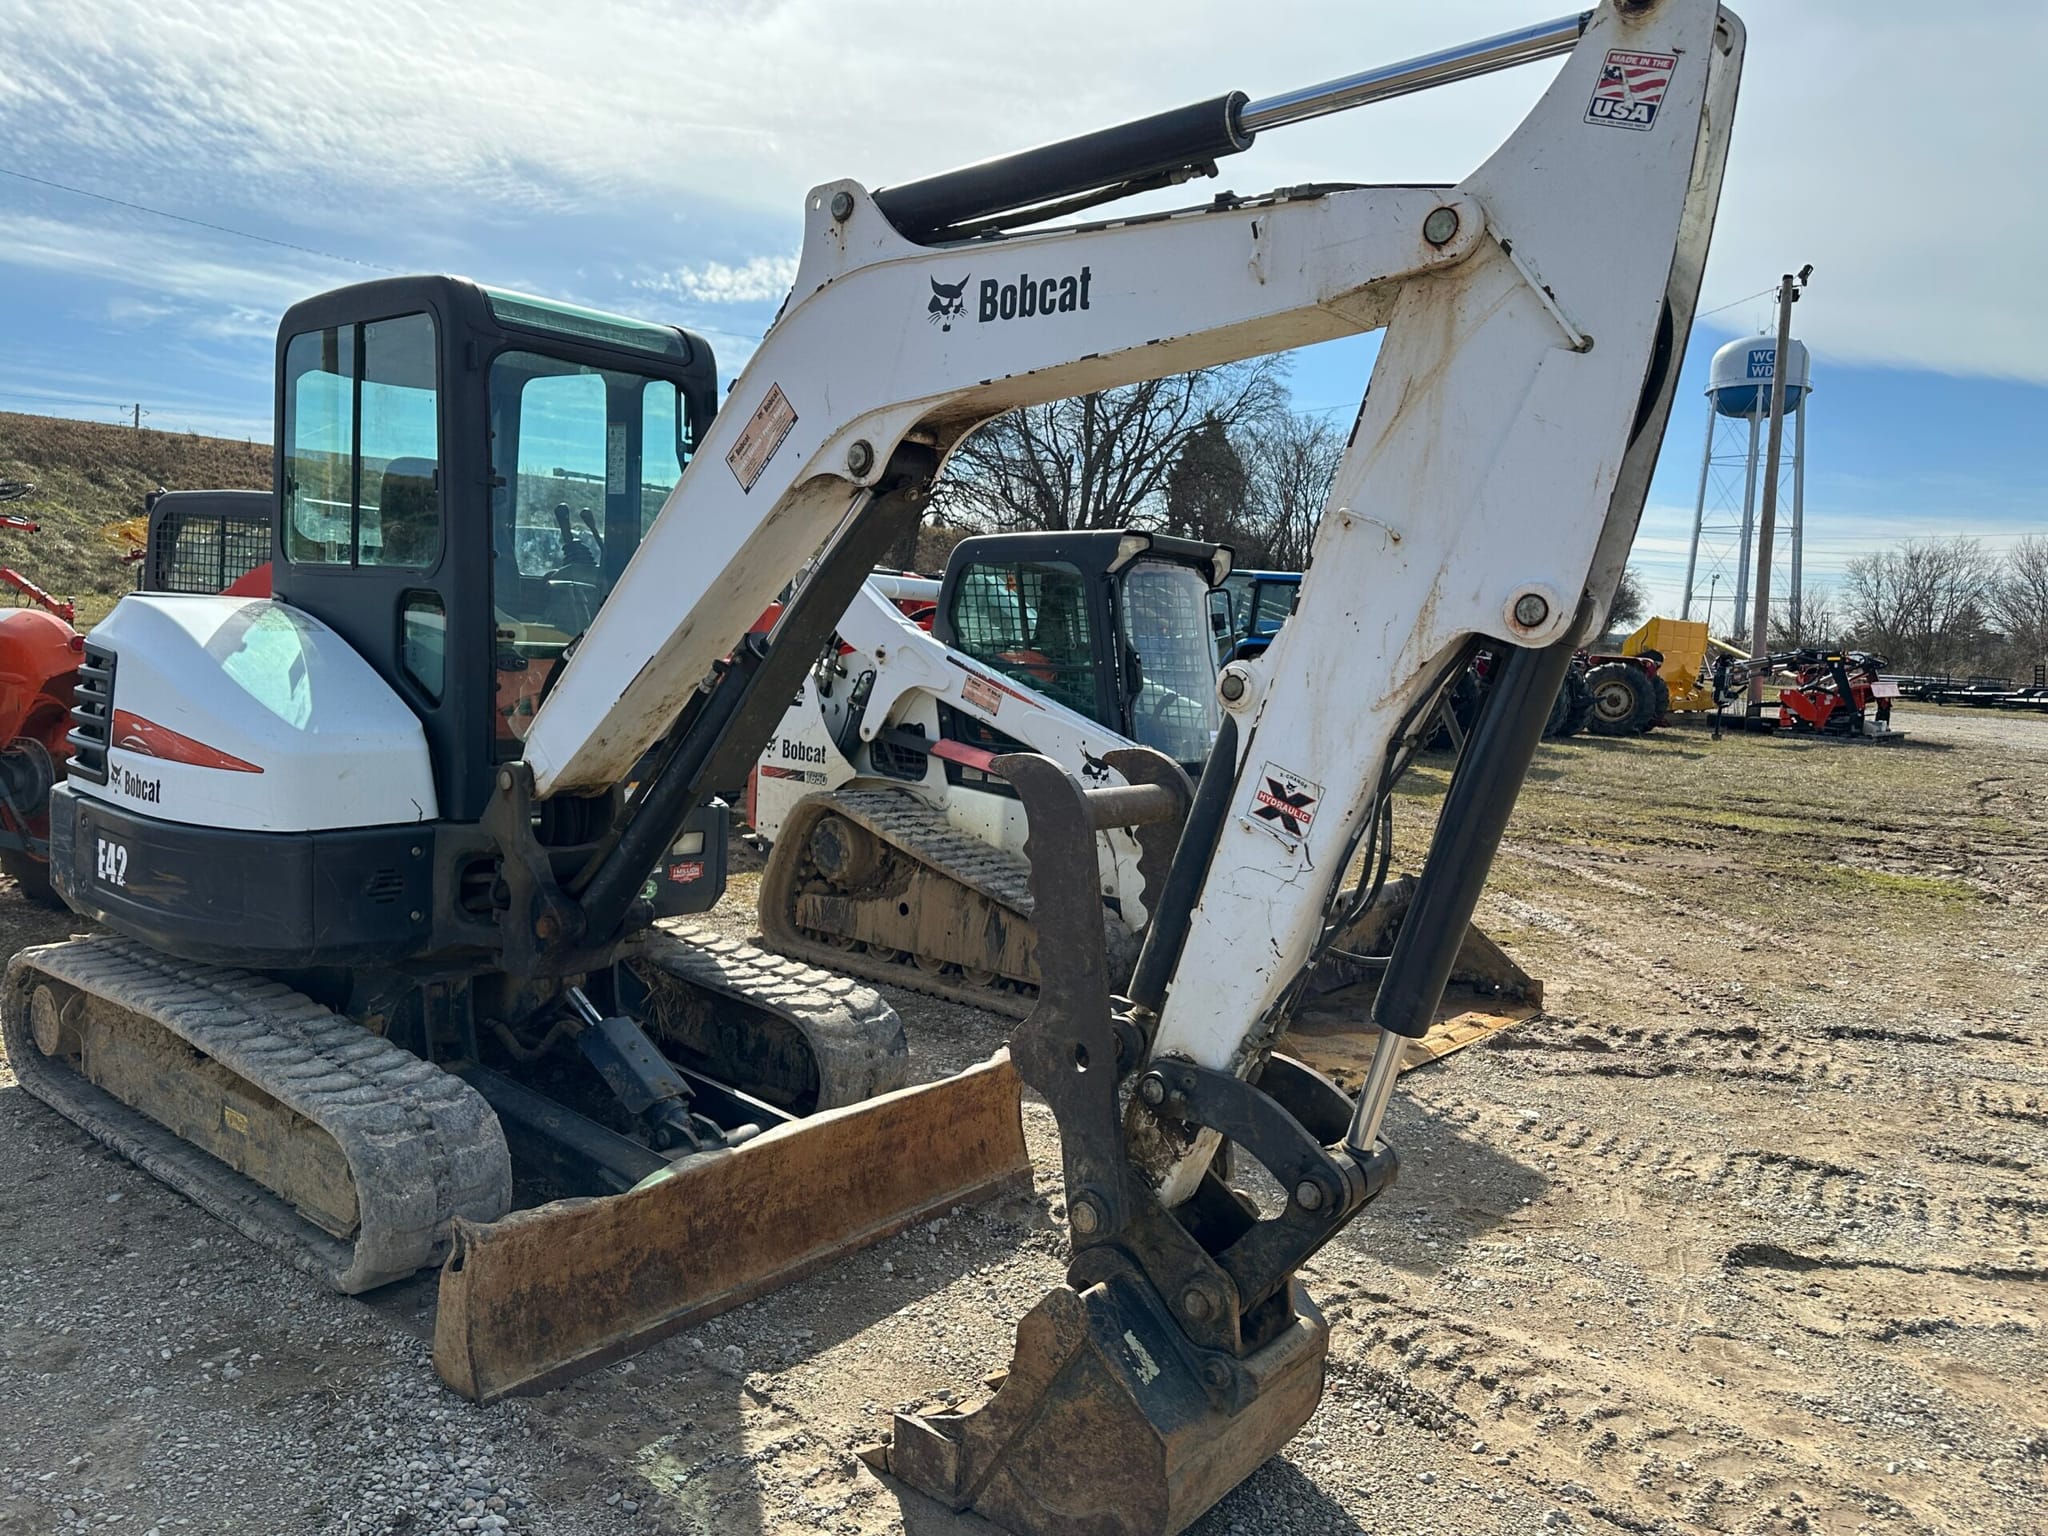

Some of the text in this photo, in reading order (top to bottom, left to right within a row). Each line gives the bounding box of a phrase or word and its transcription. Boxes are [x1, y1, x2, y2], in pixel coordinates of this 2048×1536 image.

[1610, 54, 1671, 68] MADE IN THE
[1592, 100, 1649, 122] USA
[979, 266, 1092, 323] Bobcat
[1753, 351, 1775, 363] WC
[1751, 366, 1774, 377] WD
[782, 739, 827, 764] Bobcat
[124, 770, 161, 804] Bobcat
[1259, 792, 1310, 822] HYDRAULIC
[97, 838, 128, 887] E42
